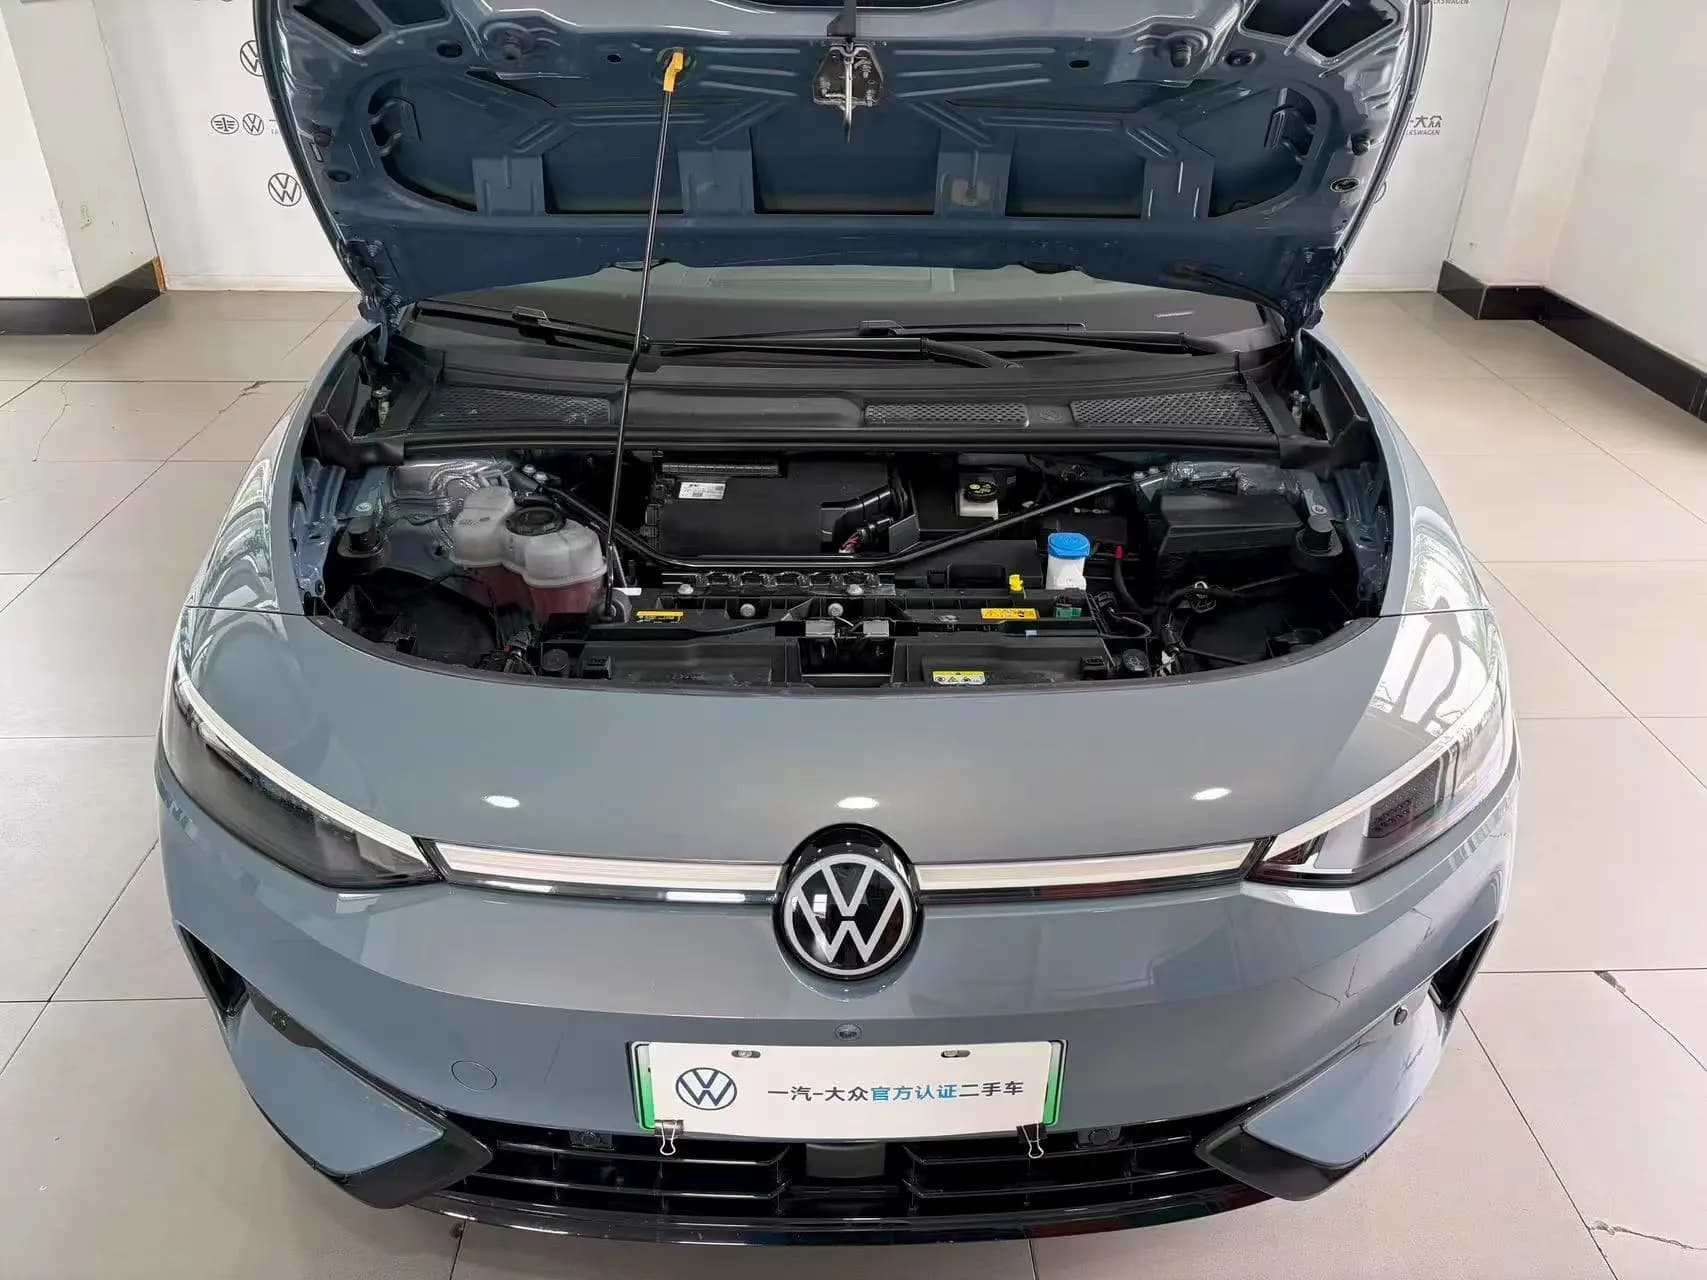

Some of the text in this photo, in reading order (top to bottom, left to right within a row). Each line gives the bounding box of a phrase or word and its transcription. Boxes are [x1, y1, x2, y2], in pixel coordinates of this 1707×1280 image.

[784, 854, 912, 975] VW
[675, 1067, 738, 1111] VW
[768, 1080, 1024, 1102] 一汽-大众官方认证二手车
